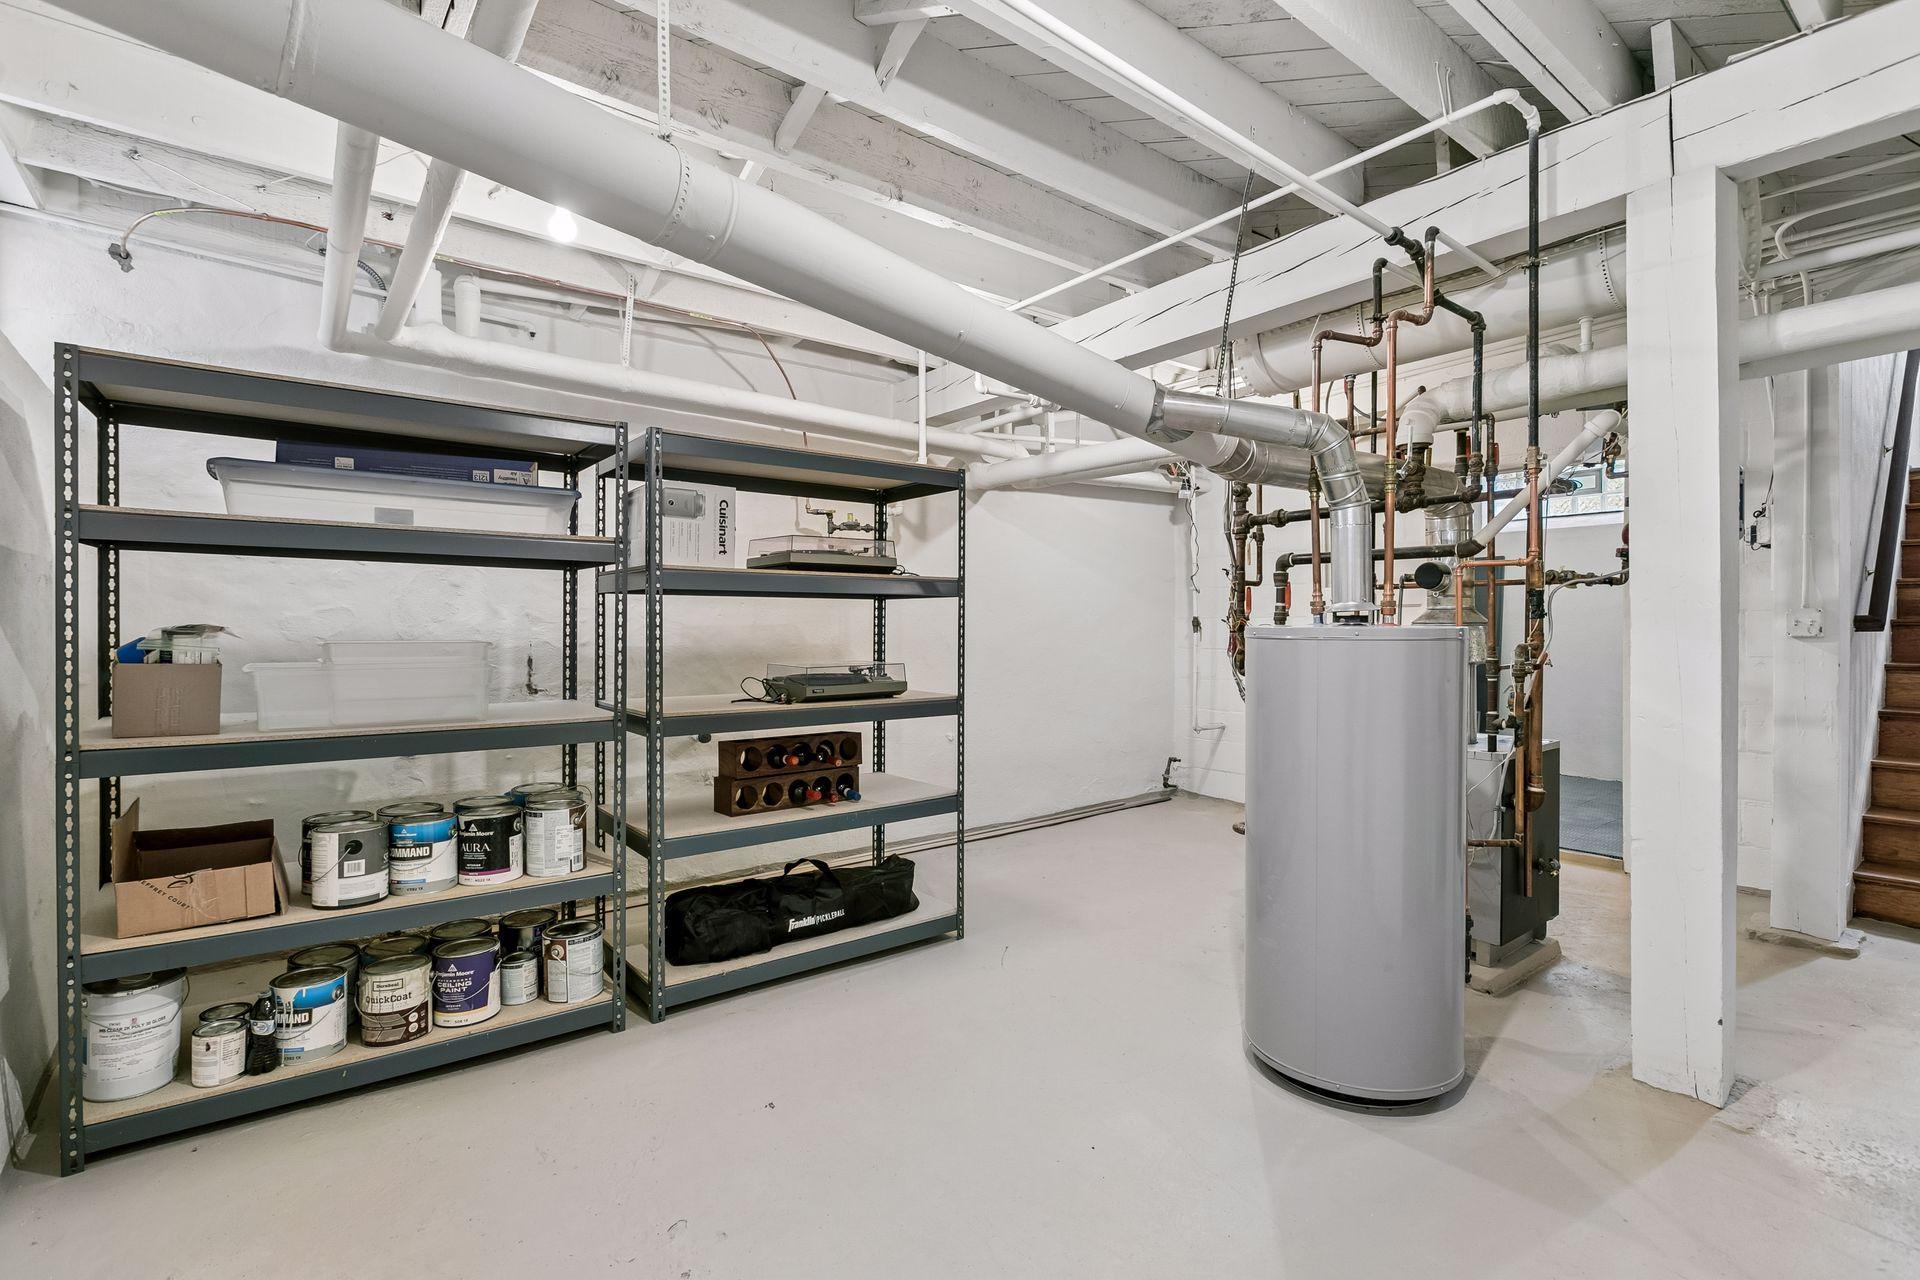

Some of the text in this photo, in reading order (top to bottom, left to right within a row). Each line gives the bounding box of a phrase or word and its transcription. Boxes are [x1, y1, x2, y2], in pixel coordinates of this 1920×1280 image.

[473, 474, 488, 482] 1213
[718, 499, 729, 555] Cuisinart
[390, 846, 430, 858] OMMAND
[462, 842, 492, 852] AURA
[140, 880, 168, 896] EFFREY
[787, 908, 845, 932] Franklin PICKLEBALL
[456, 969, 475, 977] Moore
[437, 980, 472, 988] CEILING
[365, 991, 413, 1005] QuickCoat
[274, 1012, 309, 1024] MMAND
